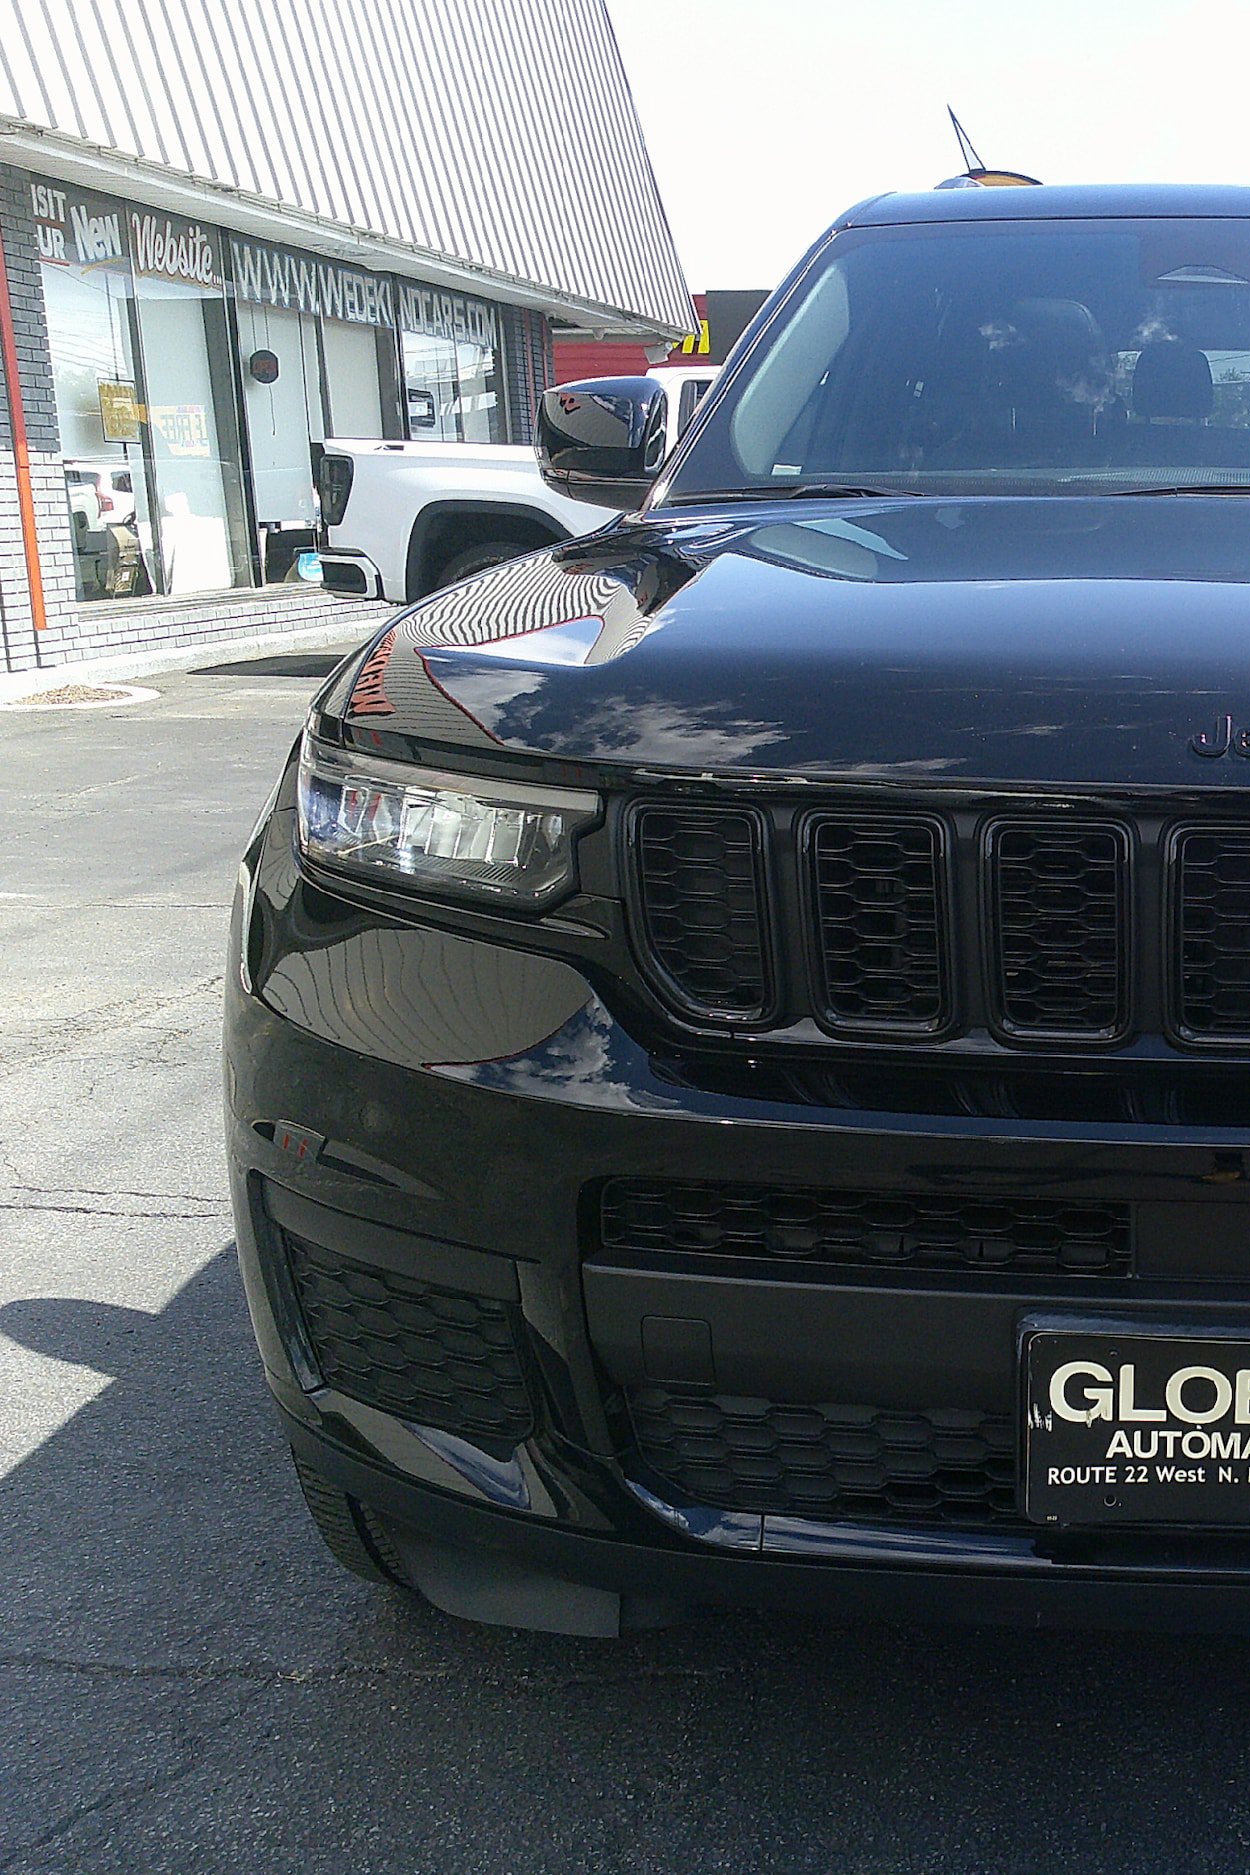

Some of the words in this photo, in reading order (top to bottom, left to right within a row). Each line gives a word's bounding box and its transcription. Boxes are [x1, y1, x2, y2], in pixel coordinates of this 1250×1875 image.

[30, 183, 67, 223] ISIT
[36, 224, 66, 260] UR
[70, 205, 123, 262] New
[1048, 1466, 1117, 1485] ROUTE
[1124, 1465, 1149, 1484] 22
[1155, 1466, 1206, 1484] West
[1218, 1466, 1239, 1484] N.
